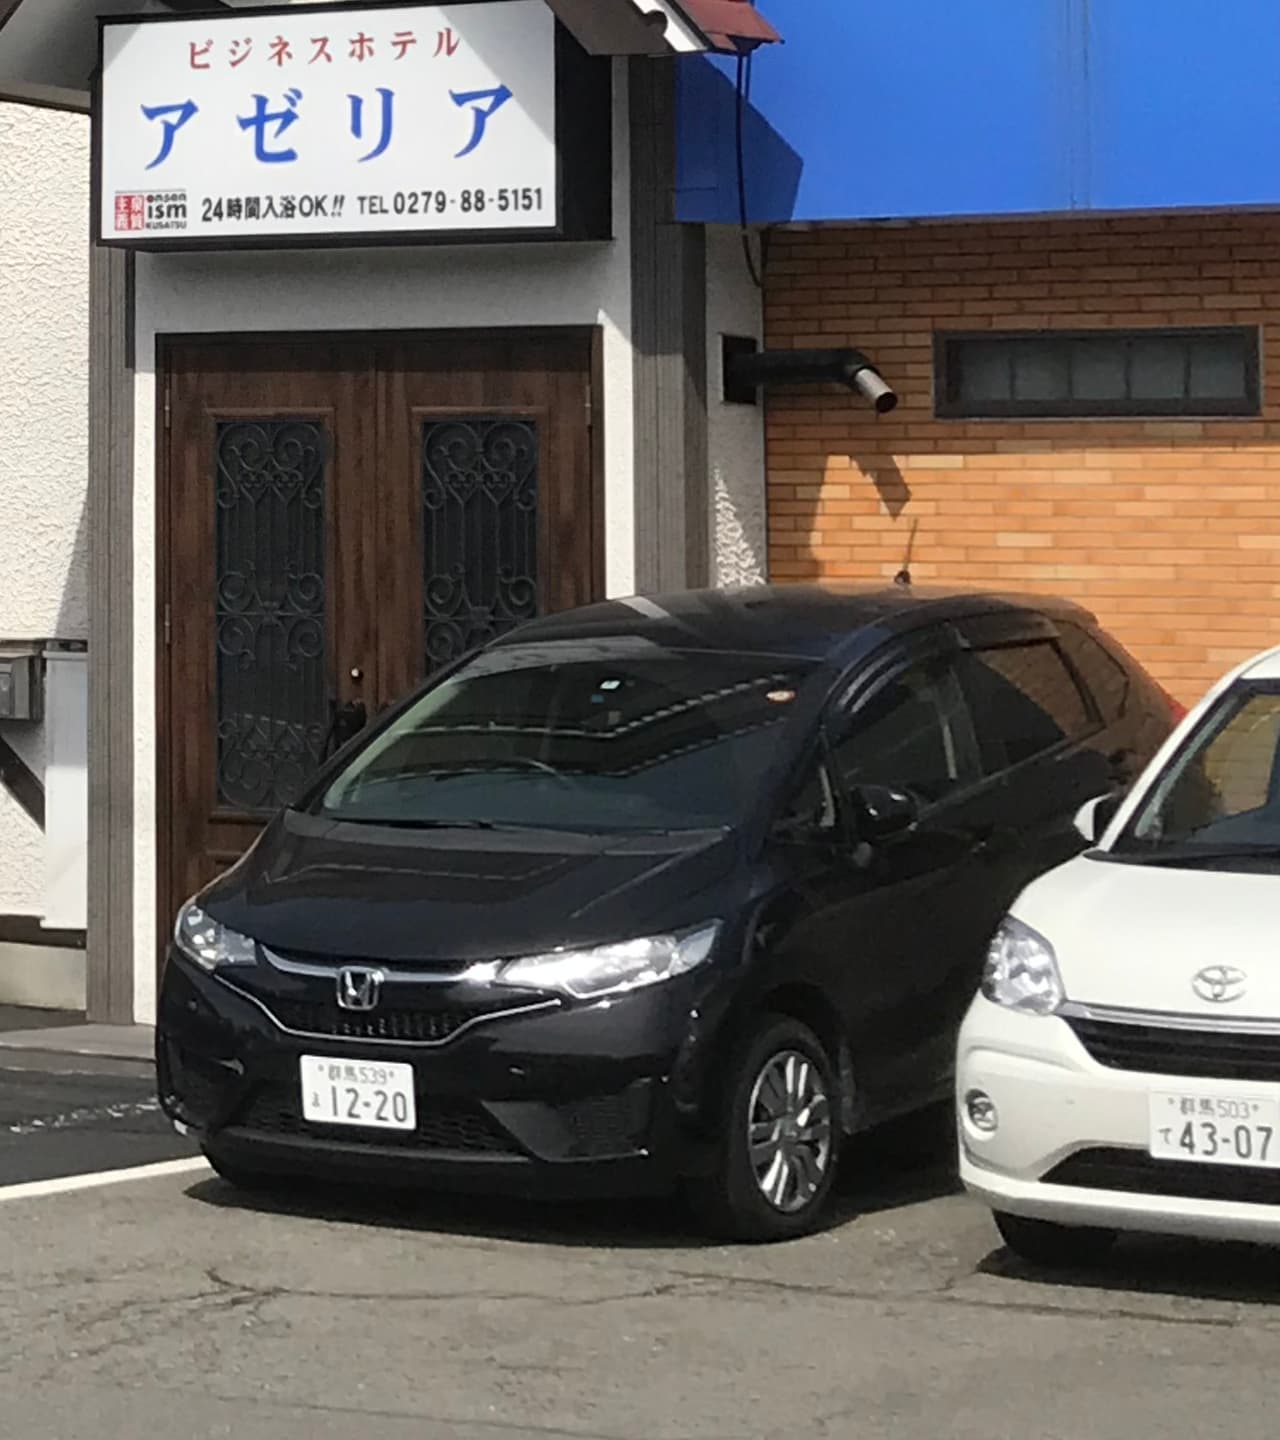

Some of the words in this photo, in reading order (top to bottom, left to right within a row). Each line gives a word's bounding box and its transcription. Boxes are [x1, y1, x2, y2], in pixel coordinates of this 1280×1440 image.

[188, 27, 461, 70] ビジネスホテル
[140, 84, 514, 170] アゼリア
[147, 204, 187, 219] ism
[357, 195, 389, 214] TEL
[393, 187, 543, 215] 0279-88-5151
[331, 1085, 408, 1123] 12-20
[1158, 1127, 1172, 1145] て
[1179, 1121, 1273, 1161] 43-07
